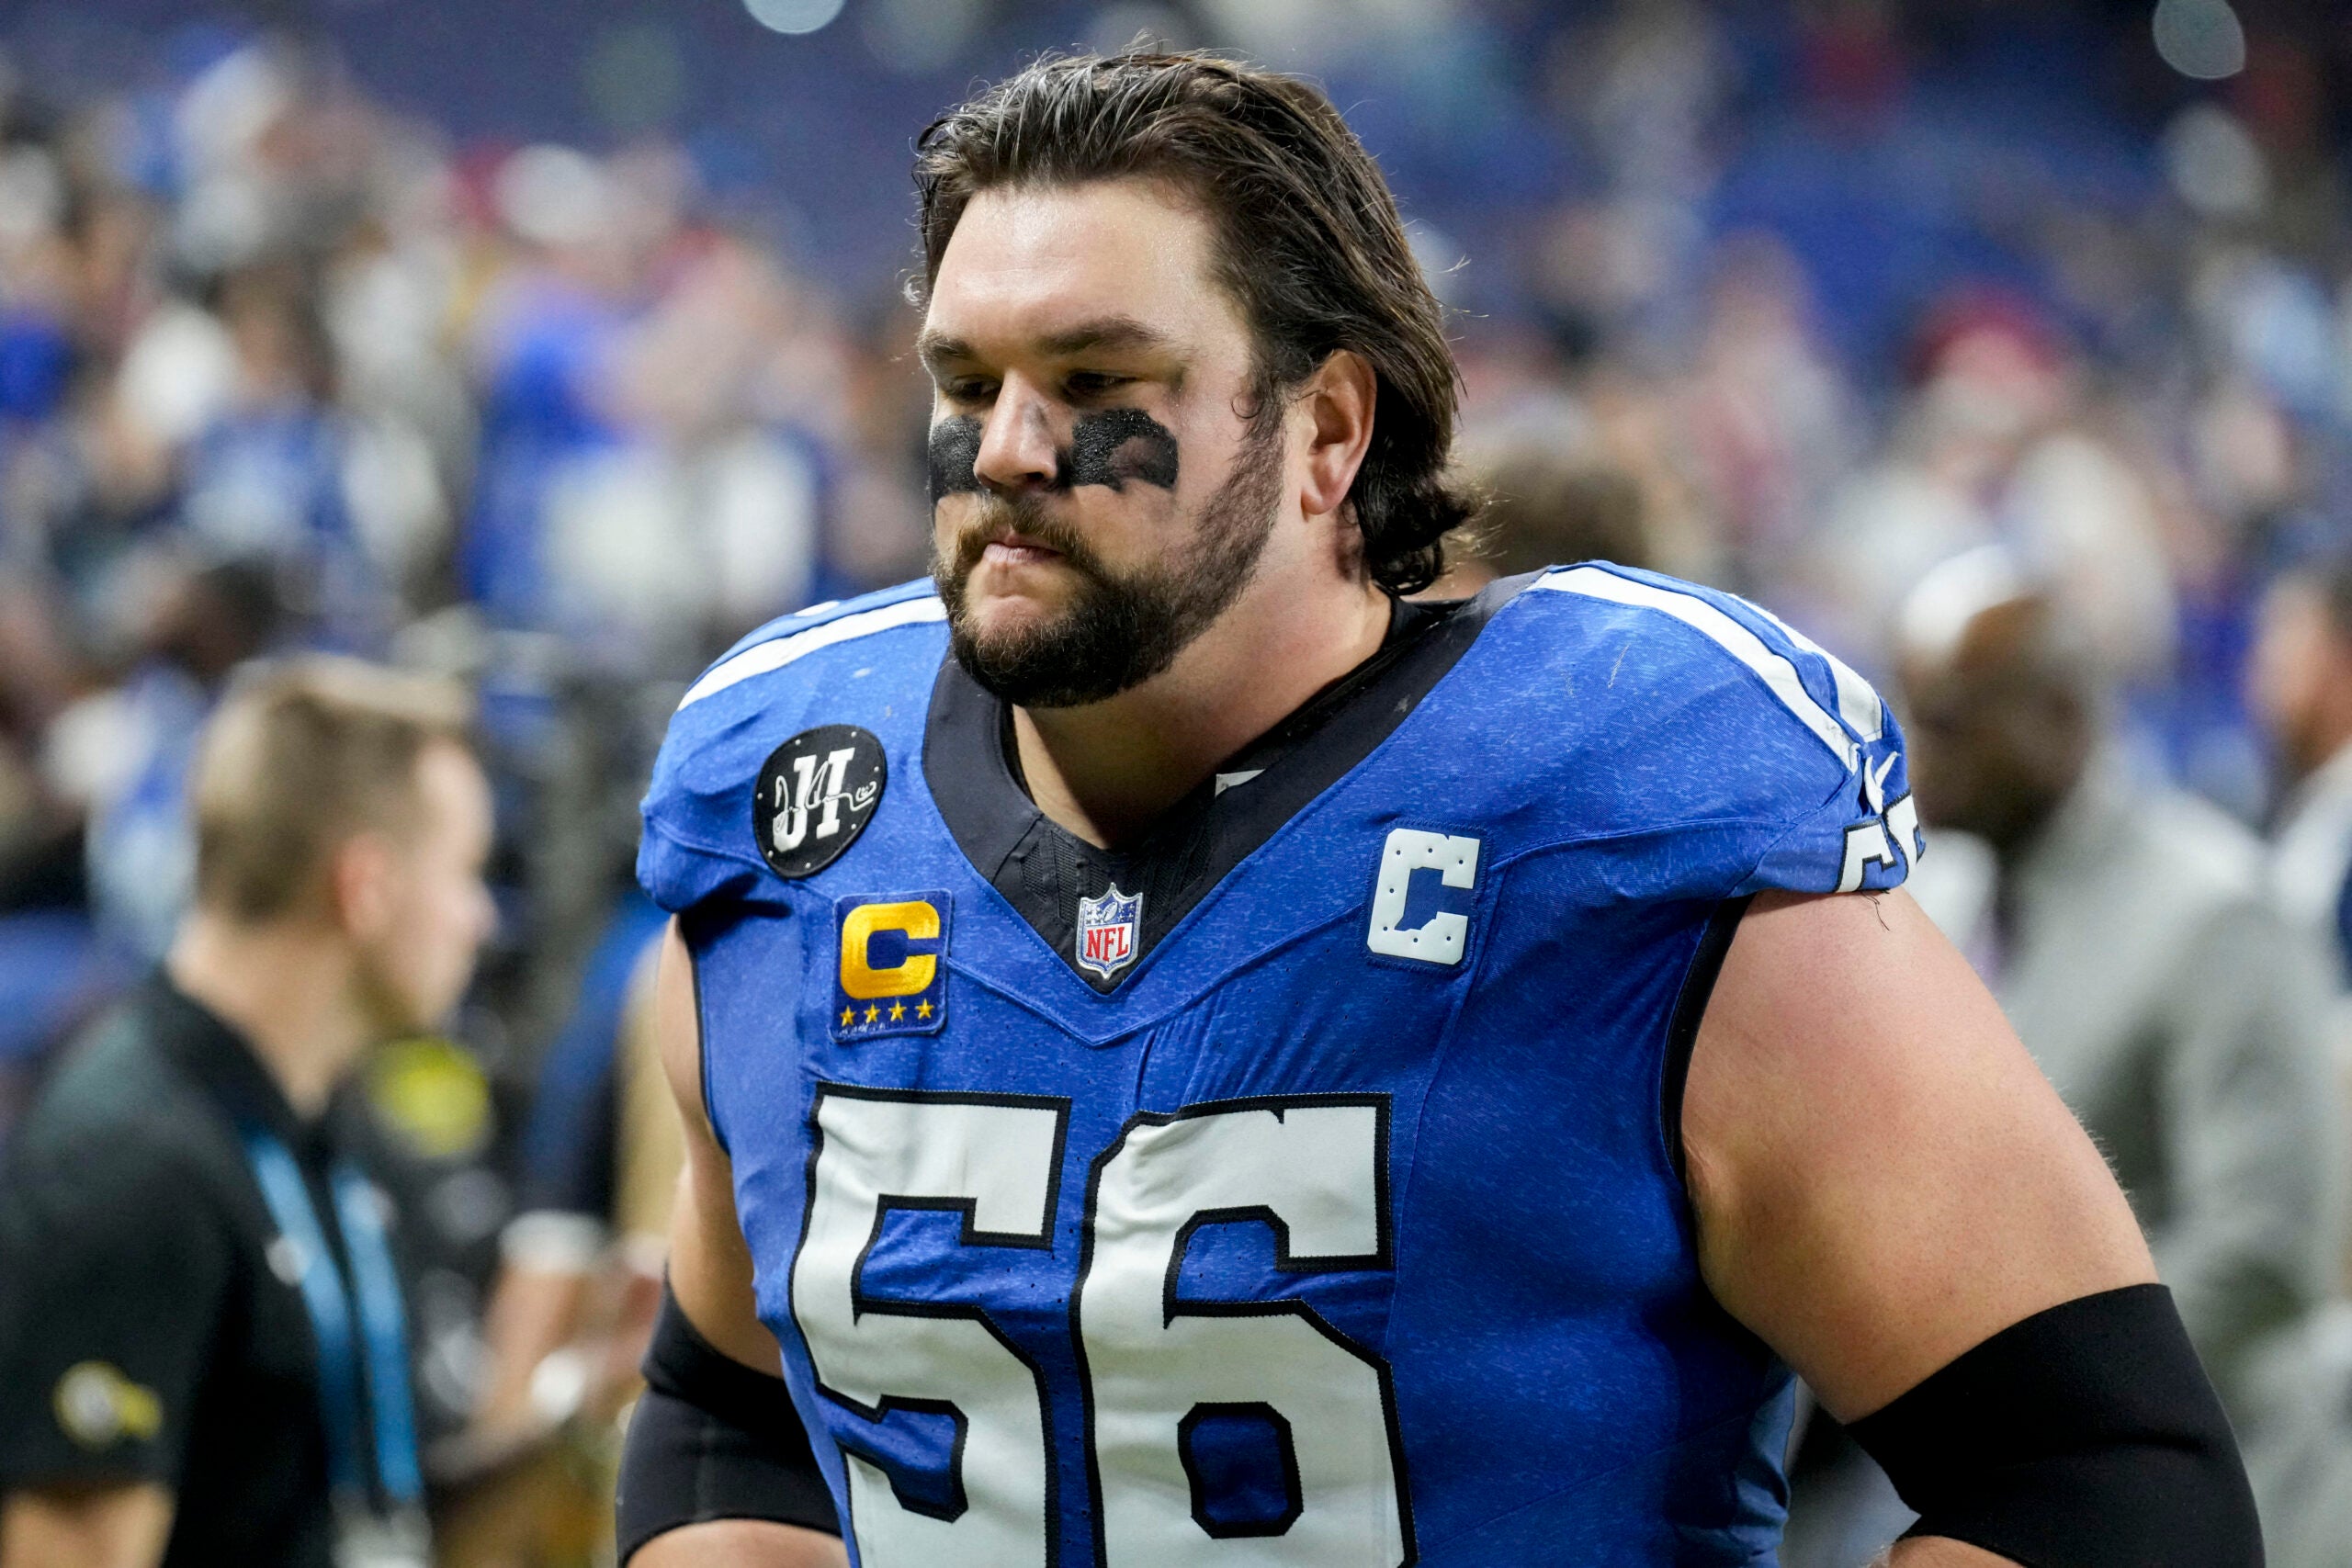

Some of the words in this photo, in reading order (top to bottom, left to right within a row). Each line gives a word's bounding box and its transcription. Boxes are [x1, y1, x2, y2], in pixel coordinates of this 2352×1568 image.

[773, 748, 855, 852] JI
[1086, 926, 1129, 962] NFL
[1367, 828, 1480, 964] C
[840, 900, 940, 999] C
[790, 1080, 1419, 1568] 56
